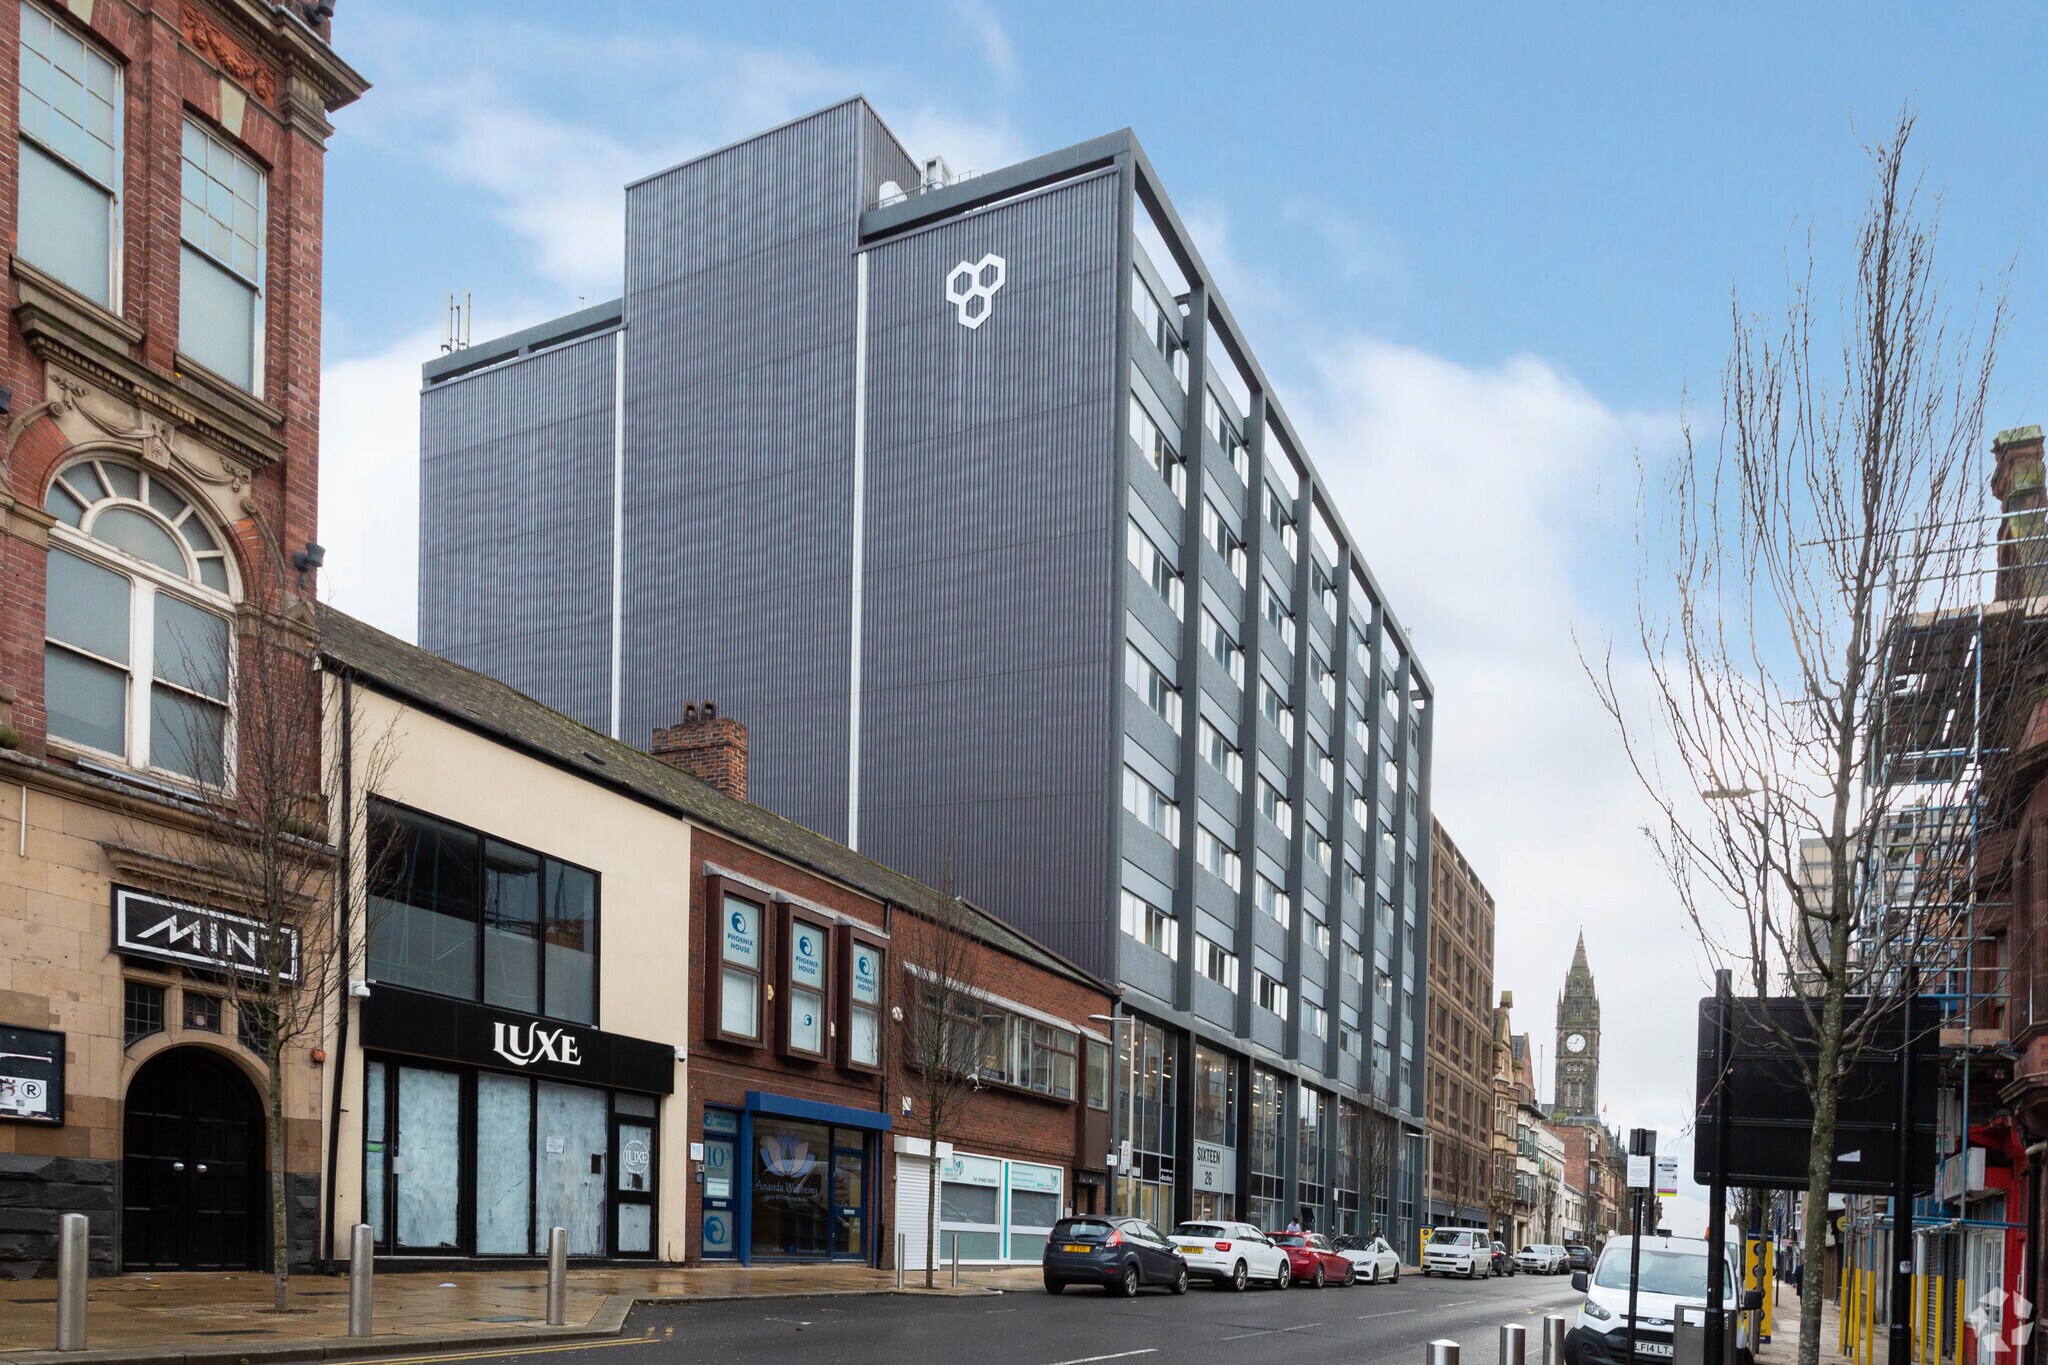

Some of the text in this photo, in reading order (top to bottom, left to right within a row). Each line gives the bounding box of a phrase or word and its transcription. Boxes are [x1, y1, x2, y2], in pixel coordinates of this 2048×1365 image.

[728, 933, 754, 947] PHOENIX
[731, 942, 750, 955] HOUSE
[795, 955, 818, 968] PHOENIX
[798, 964, 816, 975] HOUSE
[493, 1021, 582, 1066] LUXE
[625, 1150, 648, 1166] LUXE
[1197, 1146, 1221, 1165] SIXTEEN
[1204, 1171, 1213, 1186] 26
[756, 1180, 784, 1192] Ananda
